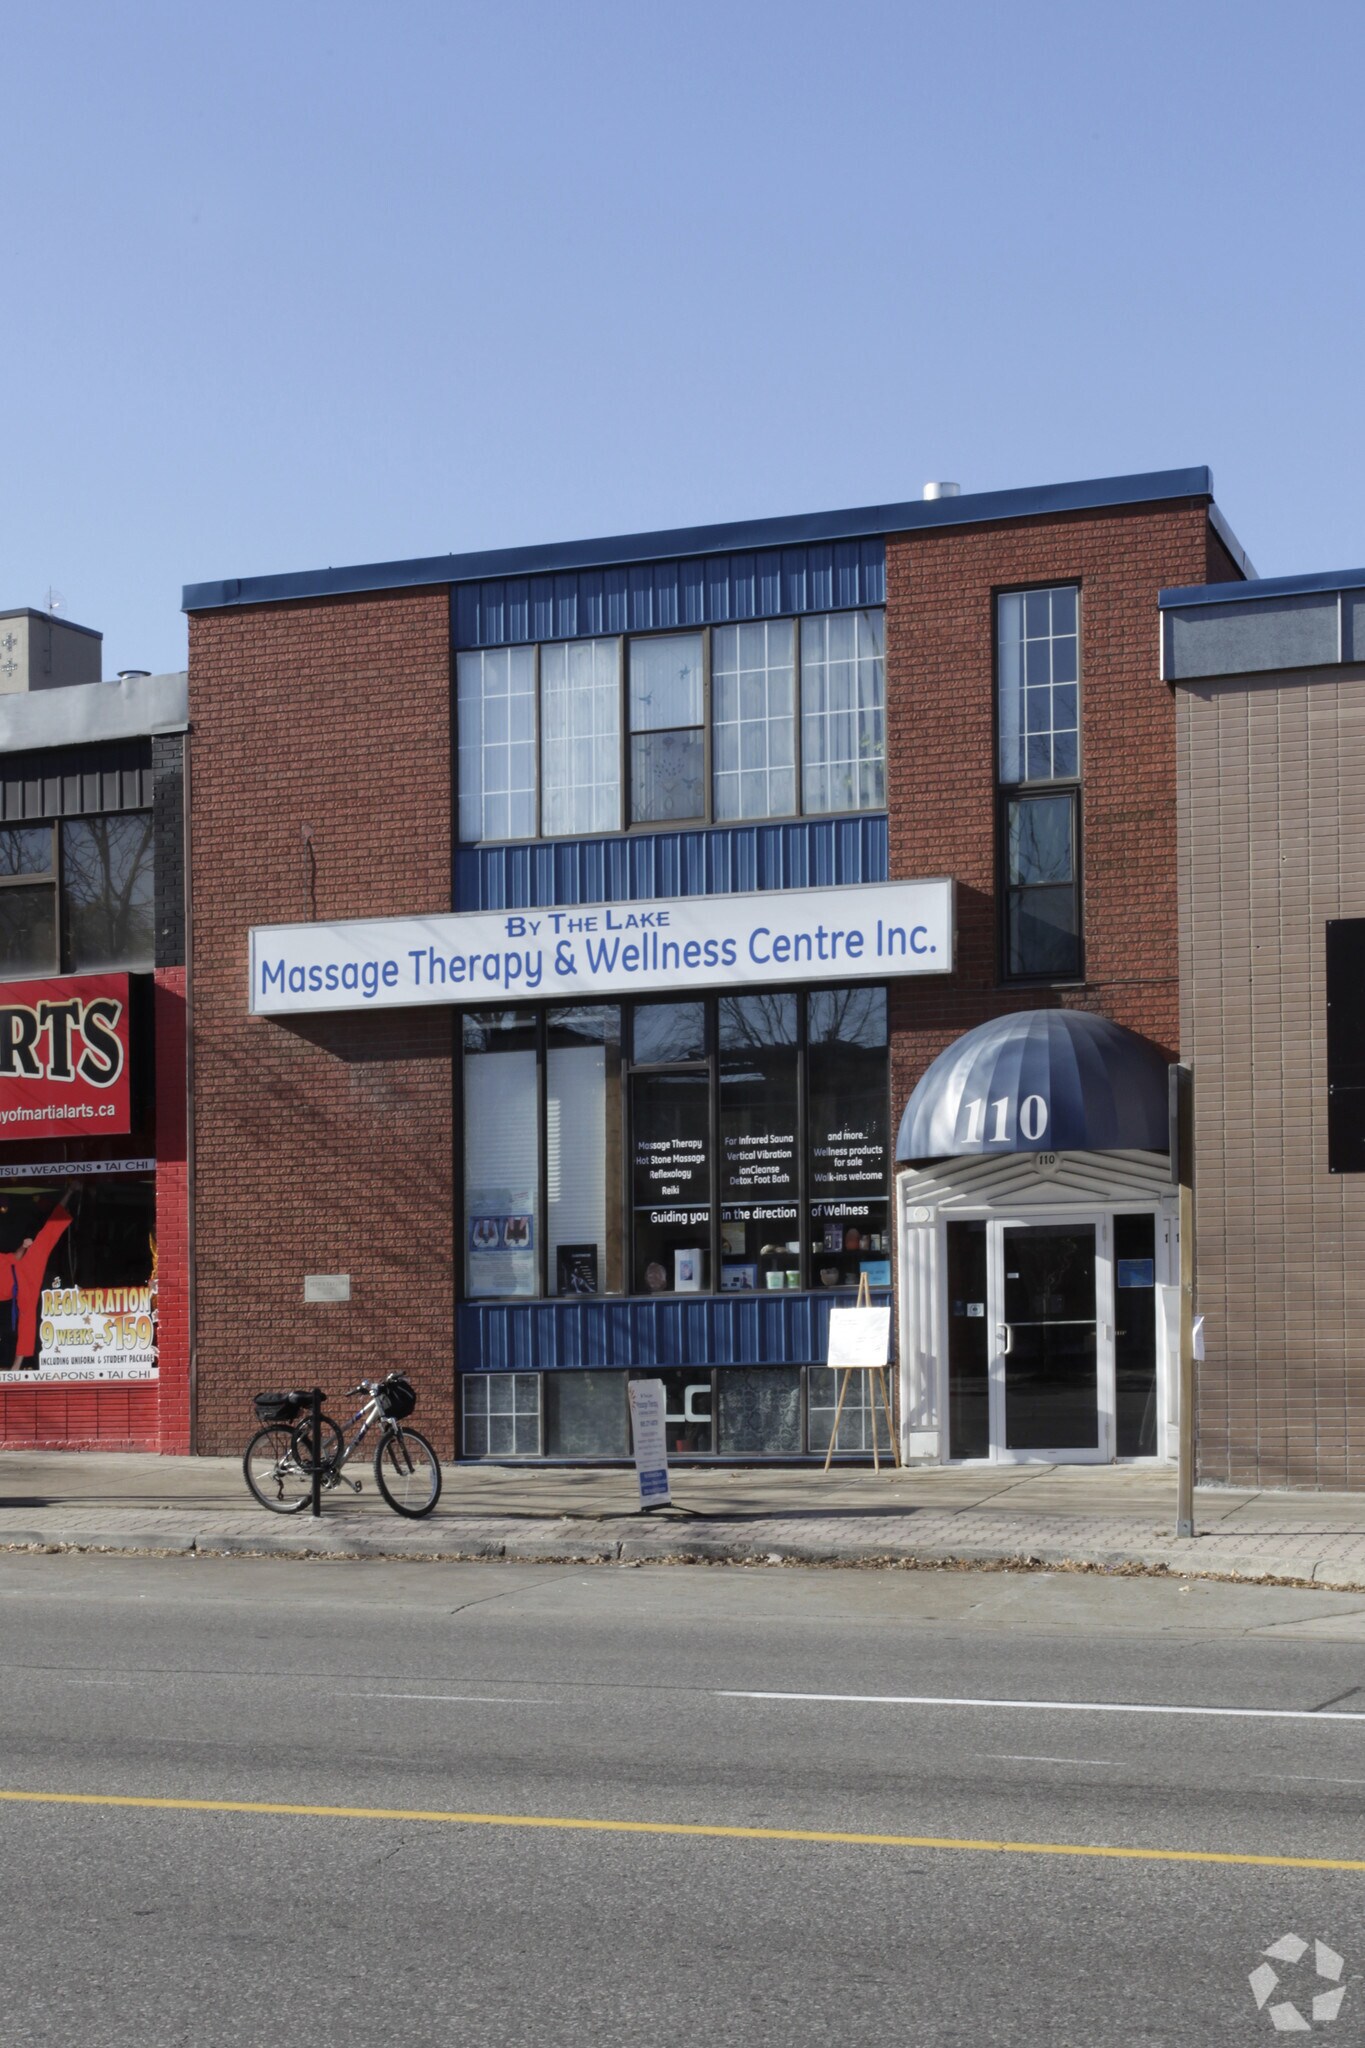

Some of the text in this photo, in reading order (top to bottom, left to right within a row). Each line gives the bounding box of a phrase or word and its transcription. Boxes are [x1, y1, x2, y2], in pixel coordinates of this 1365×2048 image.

[261, 919, 937, 999] Massage Therapy & Wellness Centre Inc.
[0, 997, 124, 1089] RTS
[960, 1094, 1049, 1144] 110
[724, 1134, 794, 1146] Far Infrared Sauna
[827, 1131, 842, 1141] and
[638, 1139, 702, 1151] Massage Therapy
[813, 1145, 883, 1157] Wellness products
[636, 1153, 705, 1165] Hot Stone Massage
[727, 1149, 792, 1161] Vertical Vibration
[1039, 1155, 1055, 1165] 110
[30, 1163, 93, 1175] WEAPONS
[105, 1162, 121, 1171] TAI
[125, 1161, 148, 1170] CHI
[834, 1157, 863, 1167] for sale
[650, 1169, 692, 1179] Reflexology
[754, 1175, 770, 1184] Foot
[772, 1173, 790, 1183] Bath
[814, 1171, 883, 1182] Walk-ins welcome
[661, 1185, 680, 1195] Reiki
[650, 1204, 869, 1225] Guiding you in the direction of Wellness
[43, 1287, 151, 1317] REGISTRATION
[41, 1320, 55, 1350] 9
[56, 1327, 94, 1346] WEEKS
[41, 1357, 69, 1366] INCLUDING
[71, 1356, 95, 1365] UNIFORM
[103, 1355, 127, 1364] STUDENT
[129, 1354, 154, 1363] PACKAGE
[33, 1371, 95, 1380] WEAPONS
[107, 1370, 123, 1379] TAI
[127, 1370, 151, 1379] CHI
